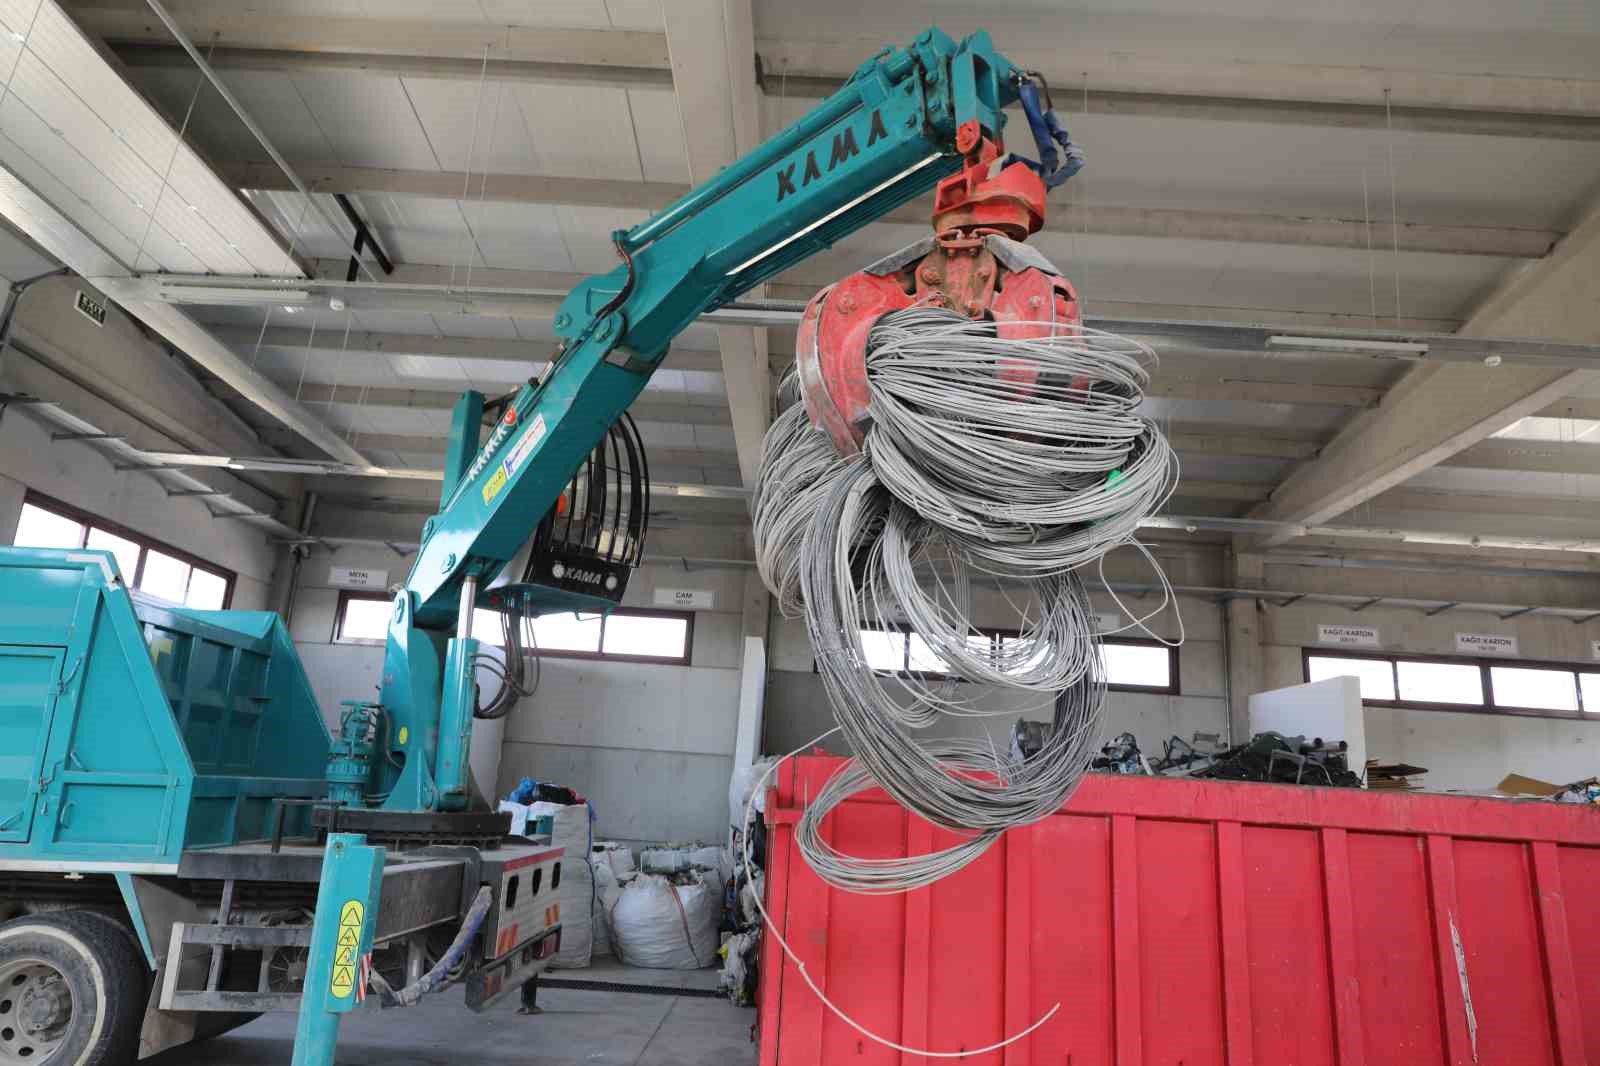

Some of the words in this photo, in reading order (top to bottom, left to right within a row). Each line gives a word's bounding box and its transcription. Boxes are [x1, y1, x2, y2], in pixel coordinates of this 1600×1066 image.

[776, 108, 888, 203] KAMA
[81, 296, 104, 320] EXIT
[469, 427, 508, 481] KAMA
[564, 567, 602, 585] KAMA
[675, 591, 693, 599] CAM
